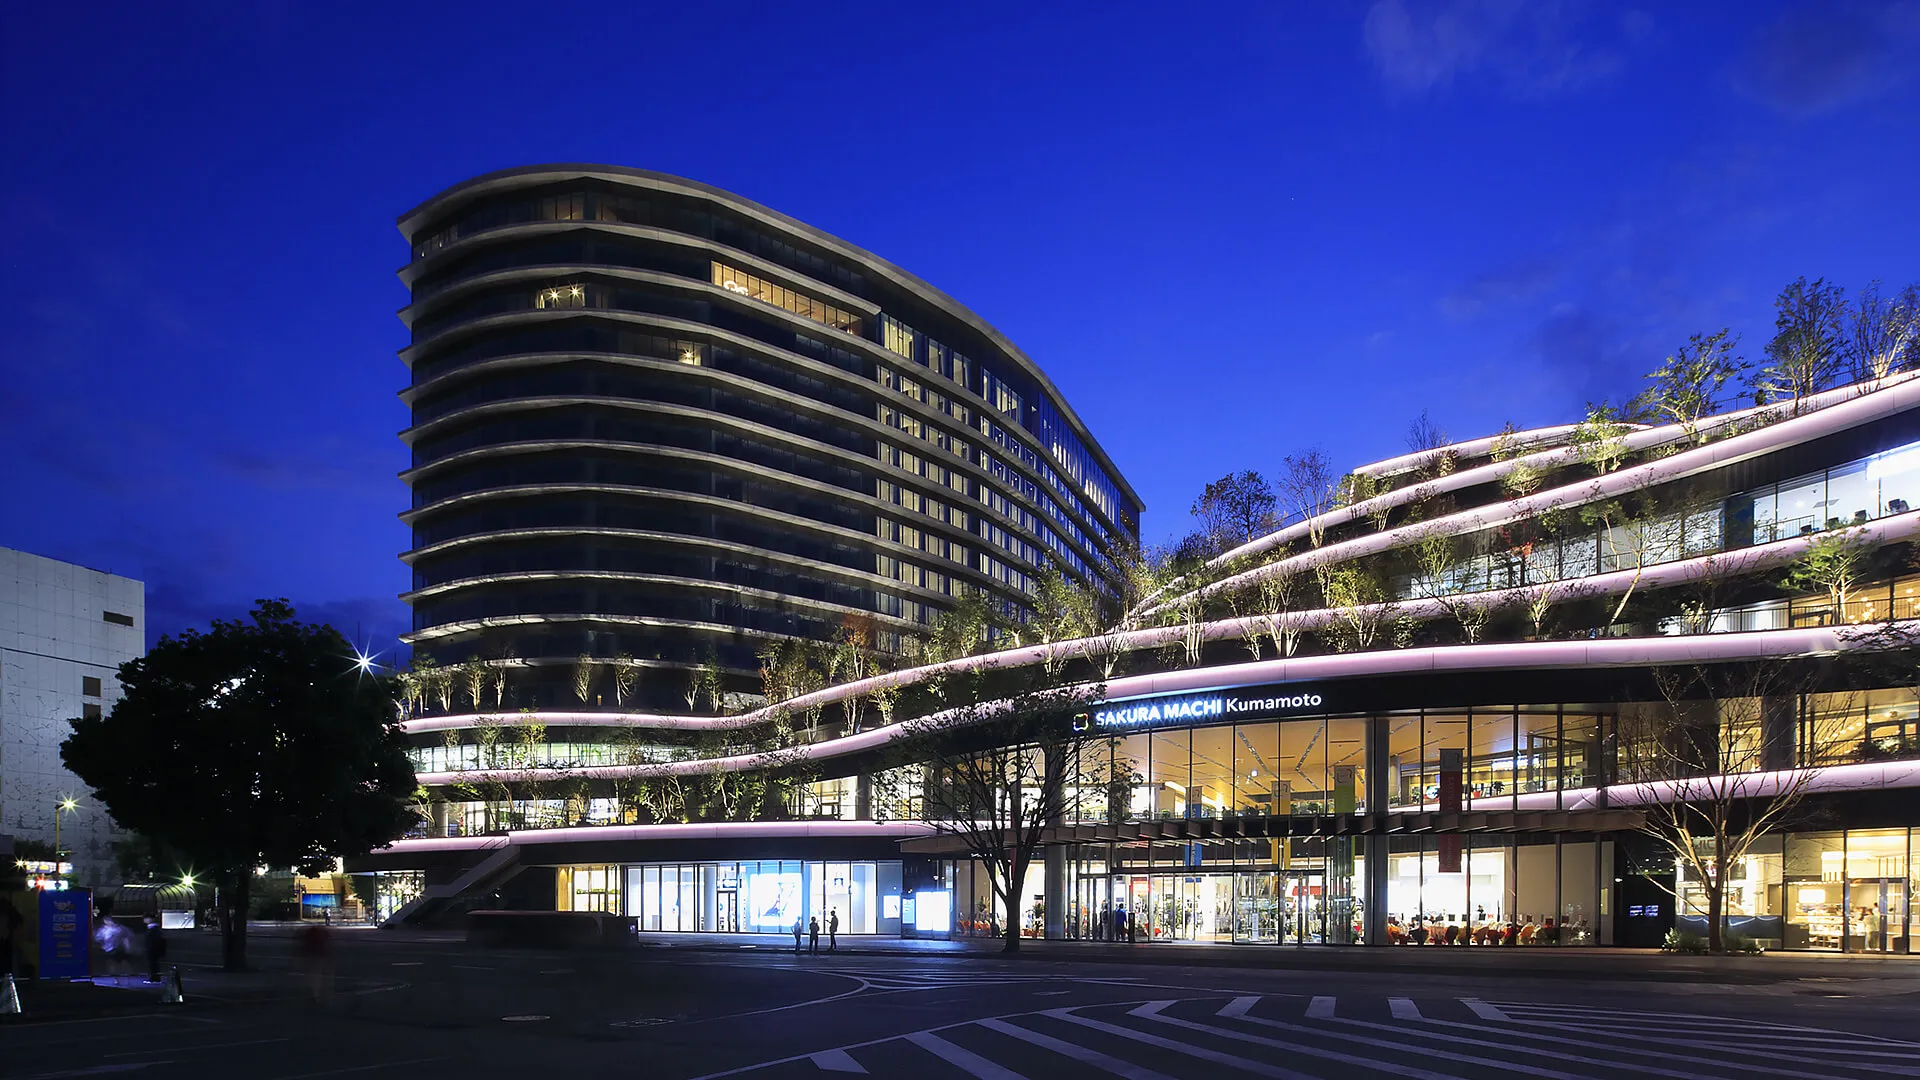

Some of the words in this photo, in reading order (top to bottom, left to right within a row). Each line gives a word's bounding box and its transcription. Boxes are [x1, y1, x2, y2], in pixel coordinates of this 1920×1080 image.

[1096, 705, 1160, 726] SAKURA
[1164, 699, 1221, 719] MACHI
[1226, 693, 1321, 712] Kumamoto
